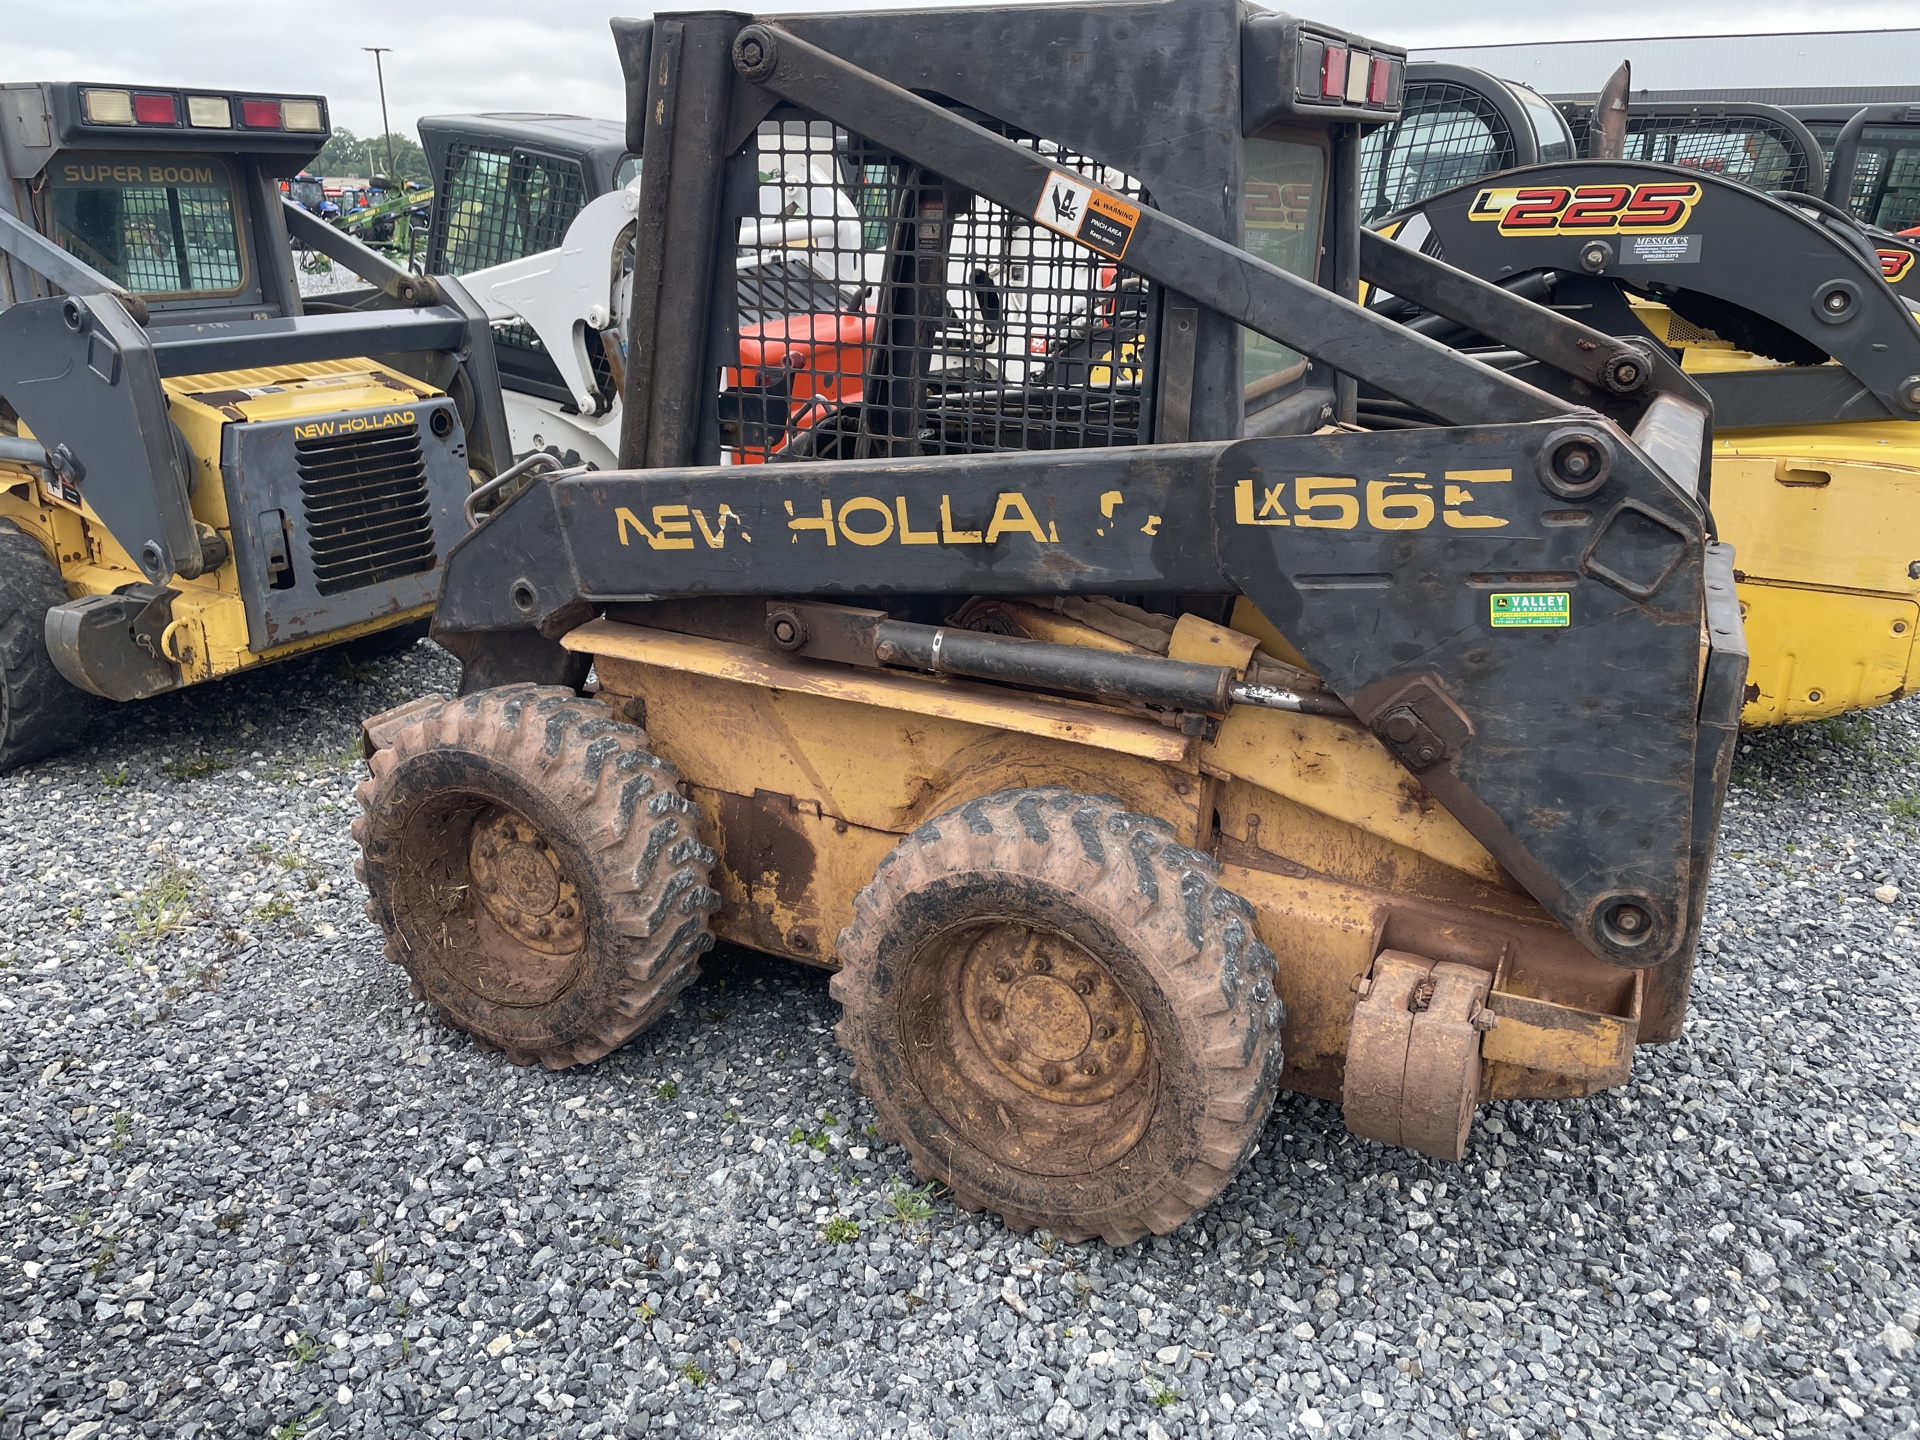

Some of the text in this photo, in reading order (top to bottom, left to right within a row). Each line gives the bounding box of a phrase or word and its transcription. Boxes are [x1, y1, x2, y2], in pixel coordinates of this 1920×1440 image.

[63, 164, 213, 184] SUPER BOOM
[1102, 202, 1134, 221] WARNING
[1469, 183, 1701, 236] L225
[1089, 229, 1116, 246] Keep away
[1090, 218, 1122, 238] PINCH AREA
[1635, 236, 1689, 245] MESSICK'S
[294, 411, 416, 440] NEW HOLLAND
[1511, 596, 1565, 607] VALLEY
